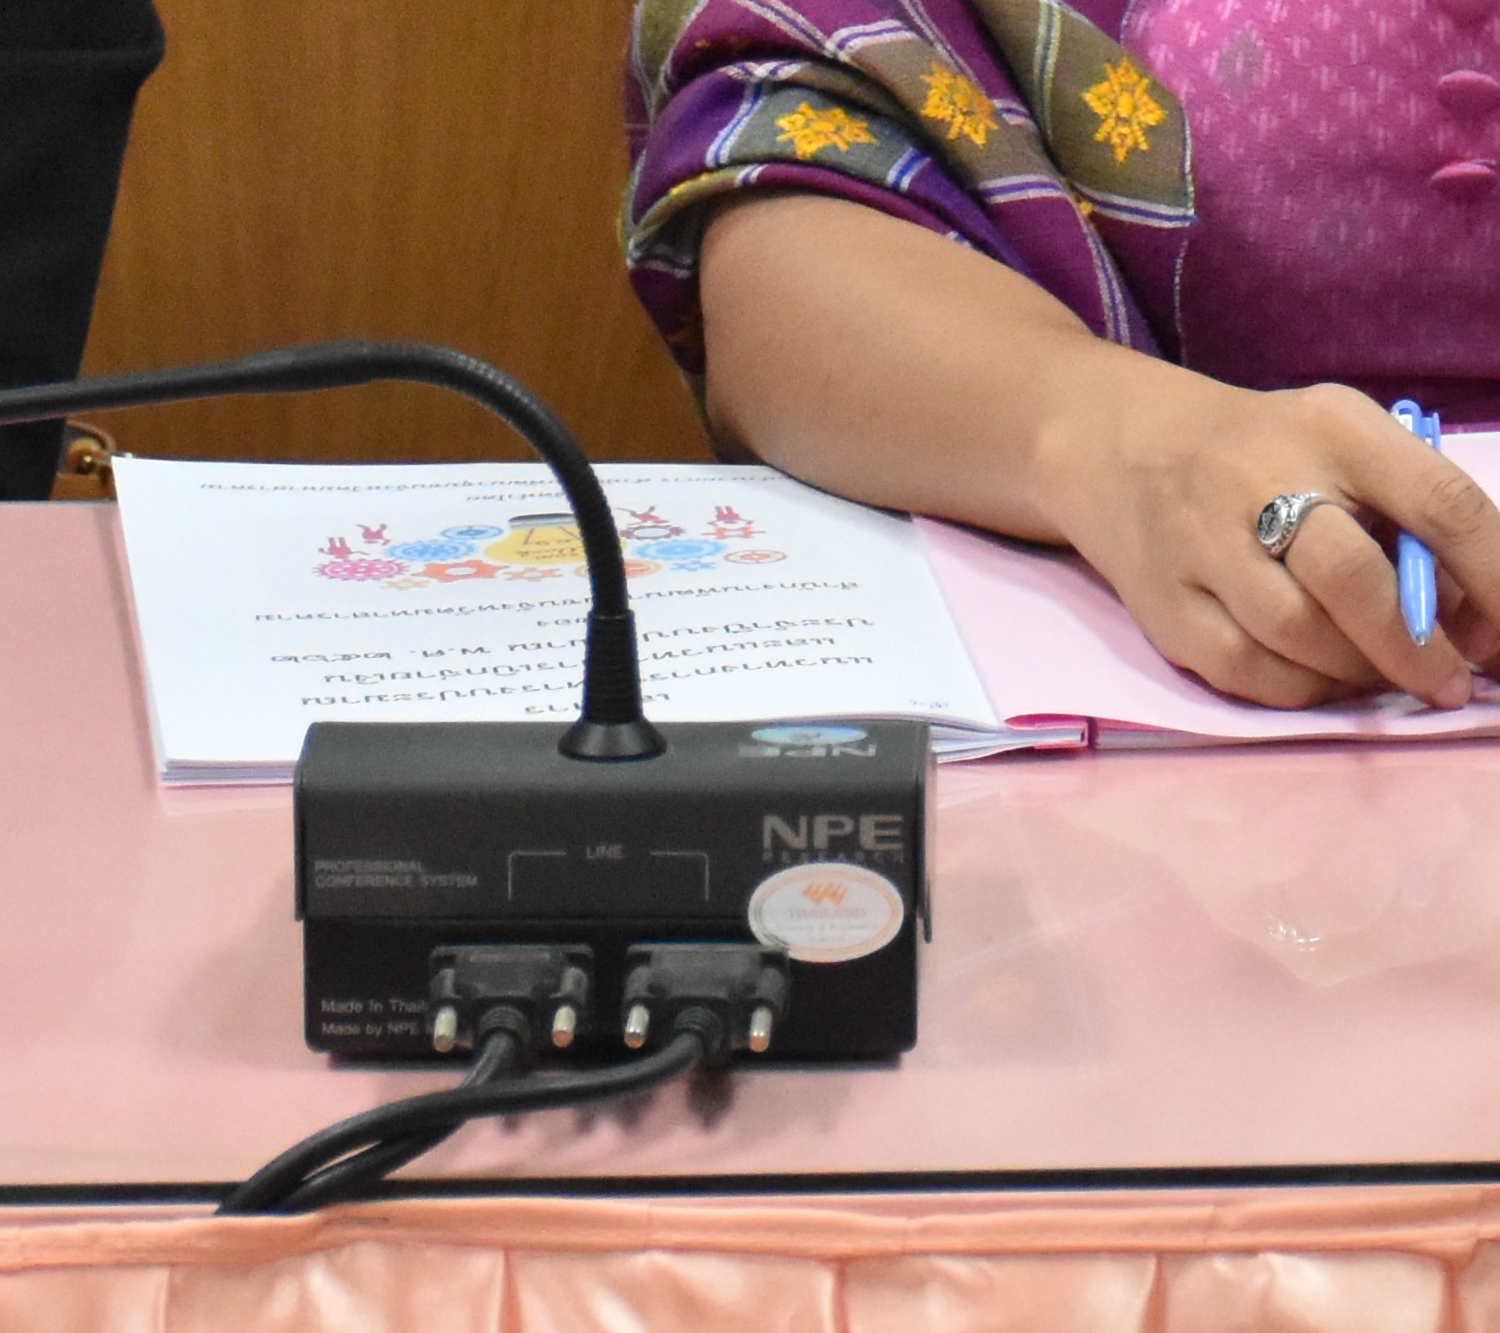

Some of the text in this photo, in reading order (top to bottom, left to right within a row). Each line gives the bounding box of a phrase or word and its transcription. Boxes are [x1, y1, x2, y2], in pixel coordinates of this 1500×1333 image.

[762, 813, 905, 851] NPE
[585, 845, 624, 860] LINE
[320, 999, 363, 1013] Made
[389, 999, 429, 1013] Thail
[321, 1022, 361, 1035] Made
[365, 1022, 383, 1037] by
[388, 1022, 419, 1035] NPE
